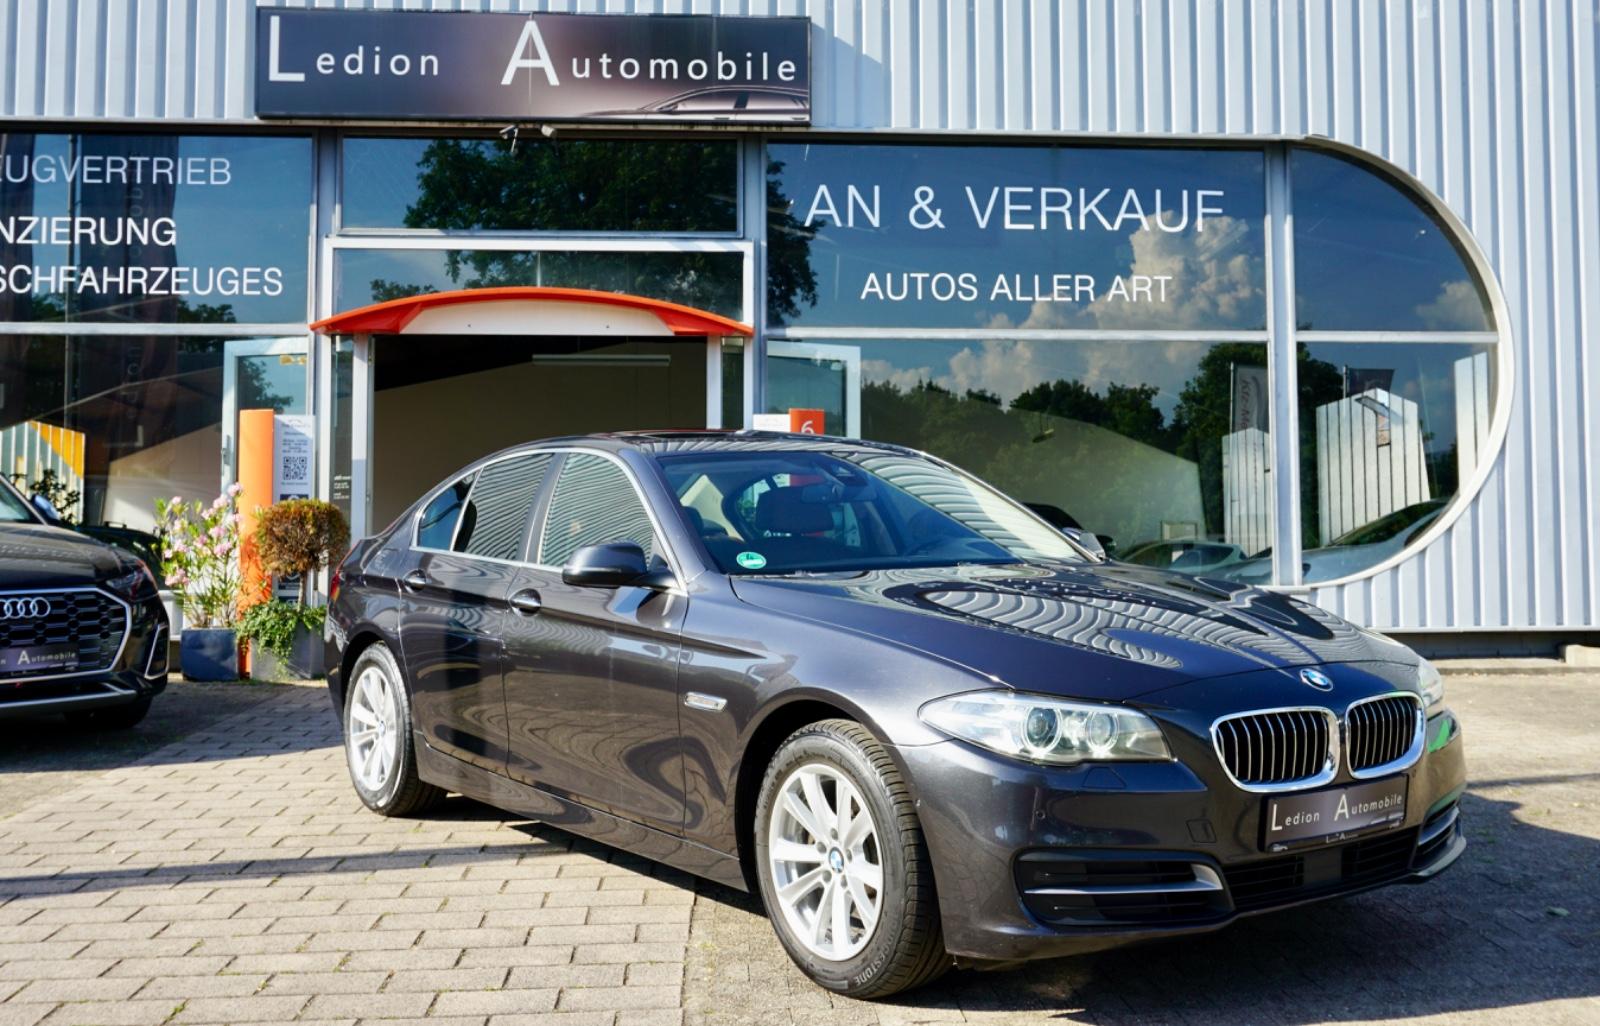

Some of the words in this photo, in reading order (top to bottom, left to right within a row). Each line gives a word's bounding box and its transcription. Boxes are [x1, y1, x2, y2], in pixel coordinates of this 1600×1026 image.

[268, 16, 440, 82] Ledion
[501, 20, 797, 86] Automobile
[0, 155, 232, 185] UGVERTRIEB
[804, 184, 881, 228] AN
[908, 186, 945, 229] &
[965, 187, 1225, 233] VERKAUF
[0, 216, 177, 246] NZIERUNG
[860, 273, 978, 301] AUTOS
[990, 274, 1095, 302] ALLER
[1107, 275, 1172, 302] ART
[1271, 804, 1320, 831] Ledion
[1334, 794, 1402, 821] Automobile
